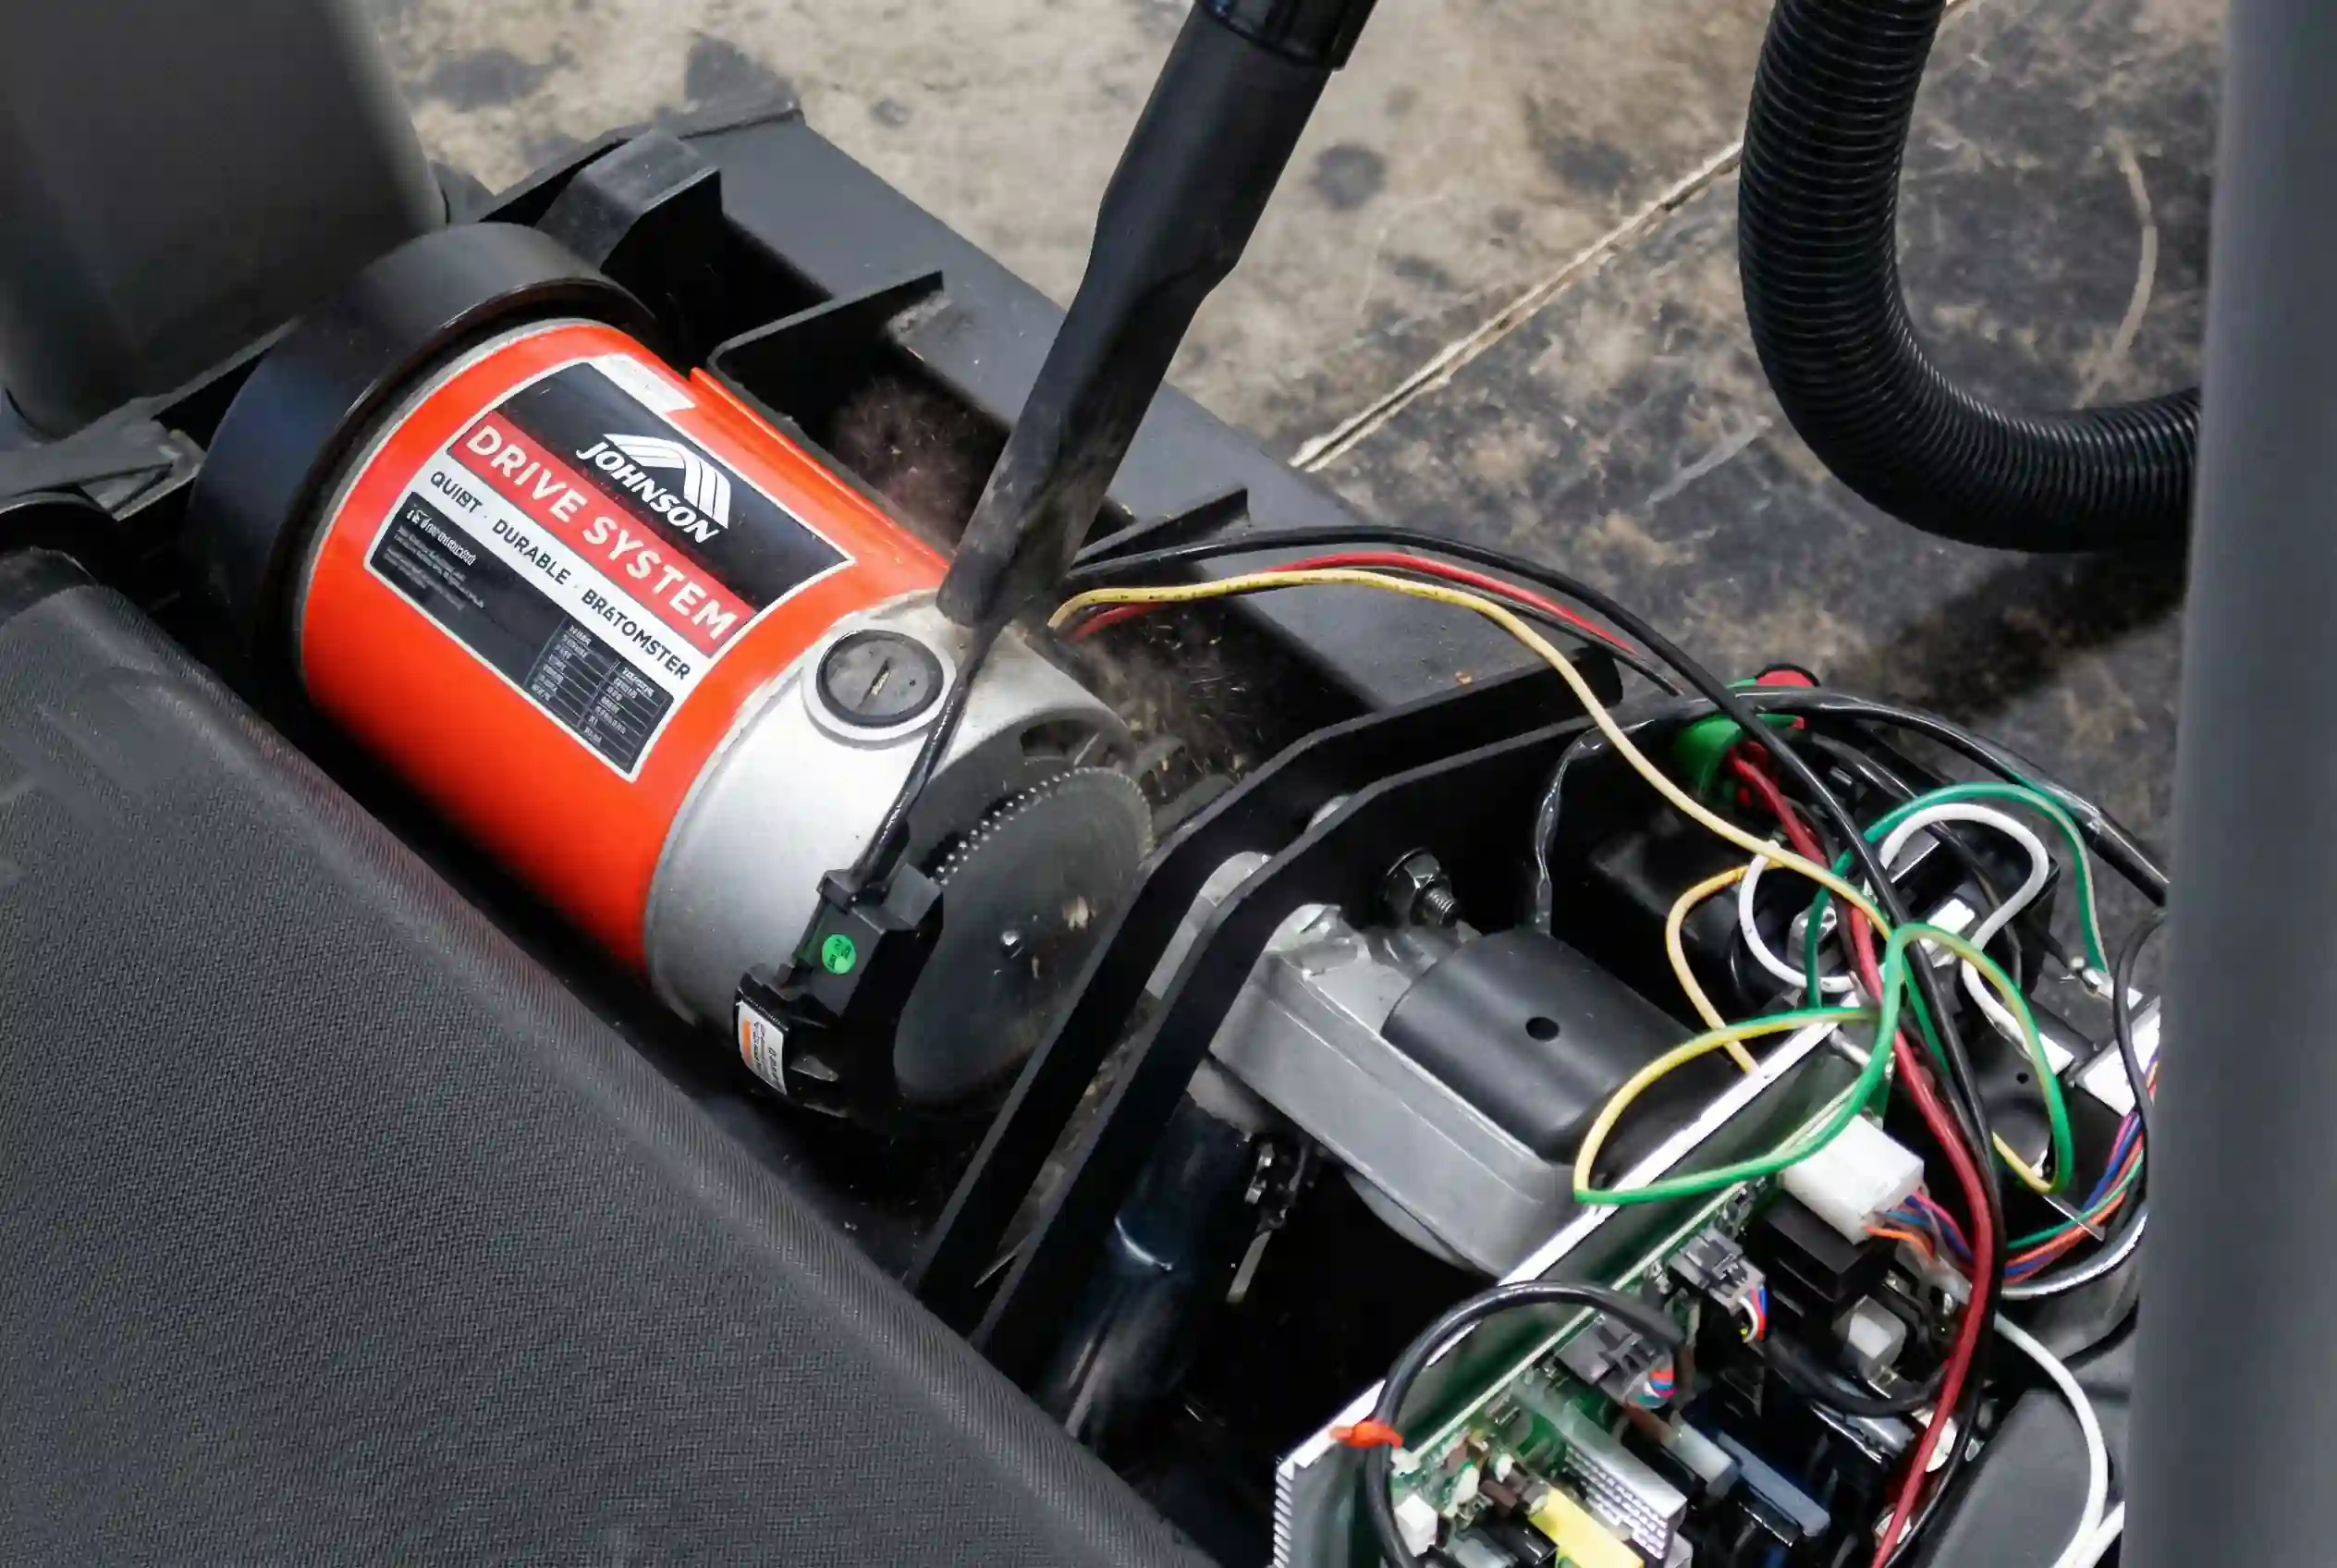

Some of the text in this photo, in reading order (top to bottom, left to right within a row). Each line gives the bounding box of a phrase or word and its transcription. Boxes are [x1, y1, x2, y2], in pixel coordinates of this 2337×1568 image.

[466, 423, 587, 523] DRIVE
[582, 518, 739, 641] SYSTEM
[576, 442, 721, 544] JOHNSON
[492, 518, 572, 586] DURABLE
